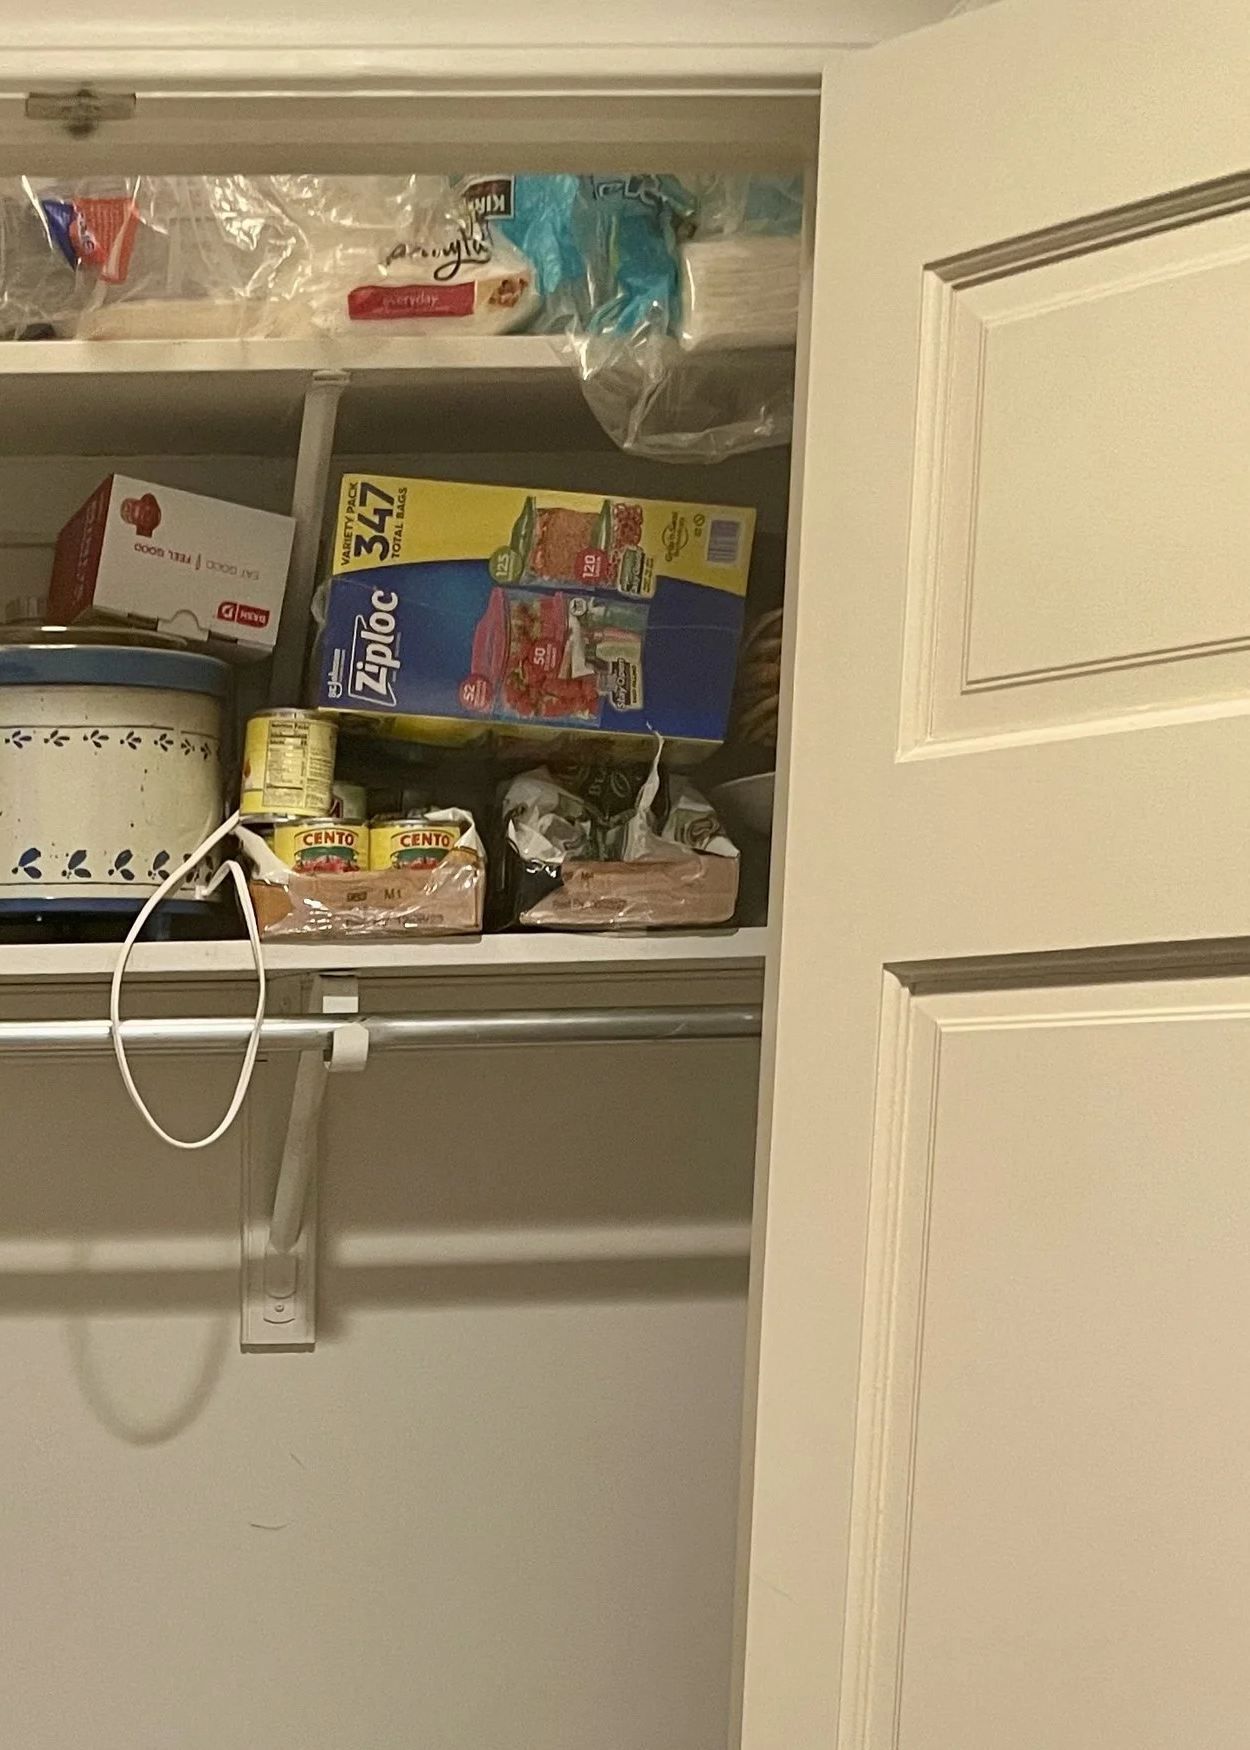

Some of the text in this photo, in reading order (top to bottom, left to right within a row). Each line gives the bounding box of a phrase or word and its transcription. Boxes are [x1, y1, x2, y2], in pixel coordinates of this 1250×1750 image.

[341, 482, 359, 567] VARIETY PACK
[354, 482, 395, 562] 347
[391, 487, 408, 560] TOTAL BAGS
[133, 542, 165, 559] GOOD
[168, 550, 192, 565] FEEL
[495, 554, 509, 577] 125
[582, 555, 596, 578] 120
[354, 589, 401, 696] Ziploc
[533, 647, 546, 666] 50
[302, 830, 355, 847] CENTO
[399, 832, 451, 848] CENTO
